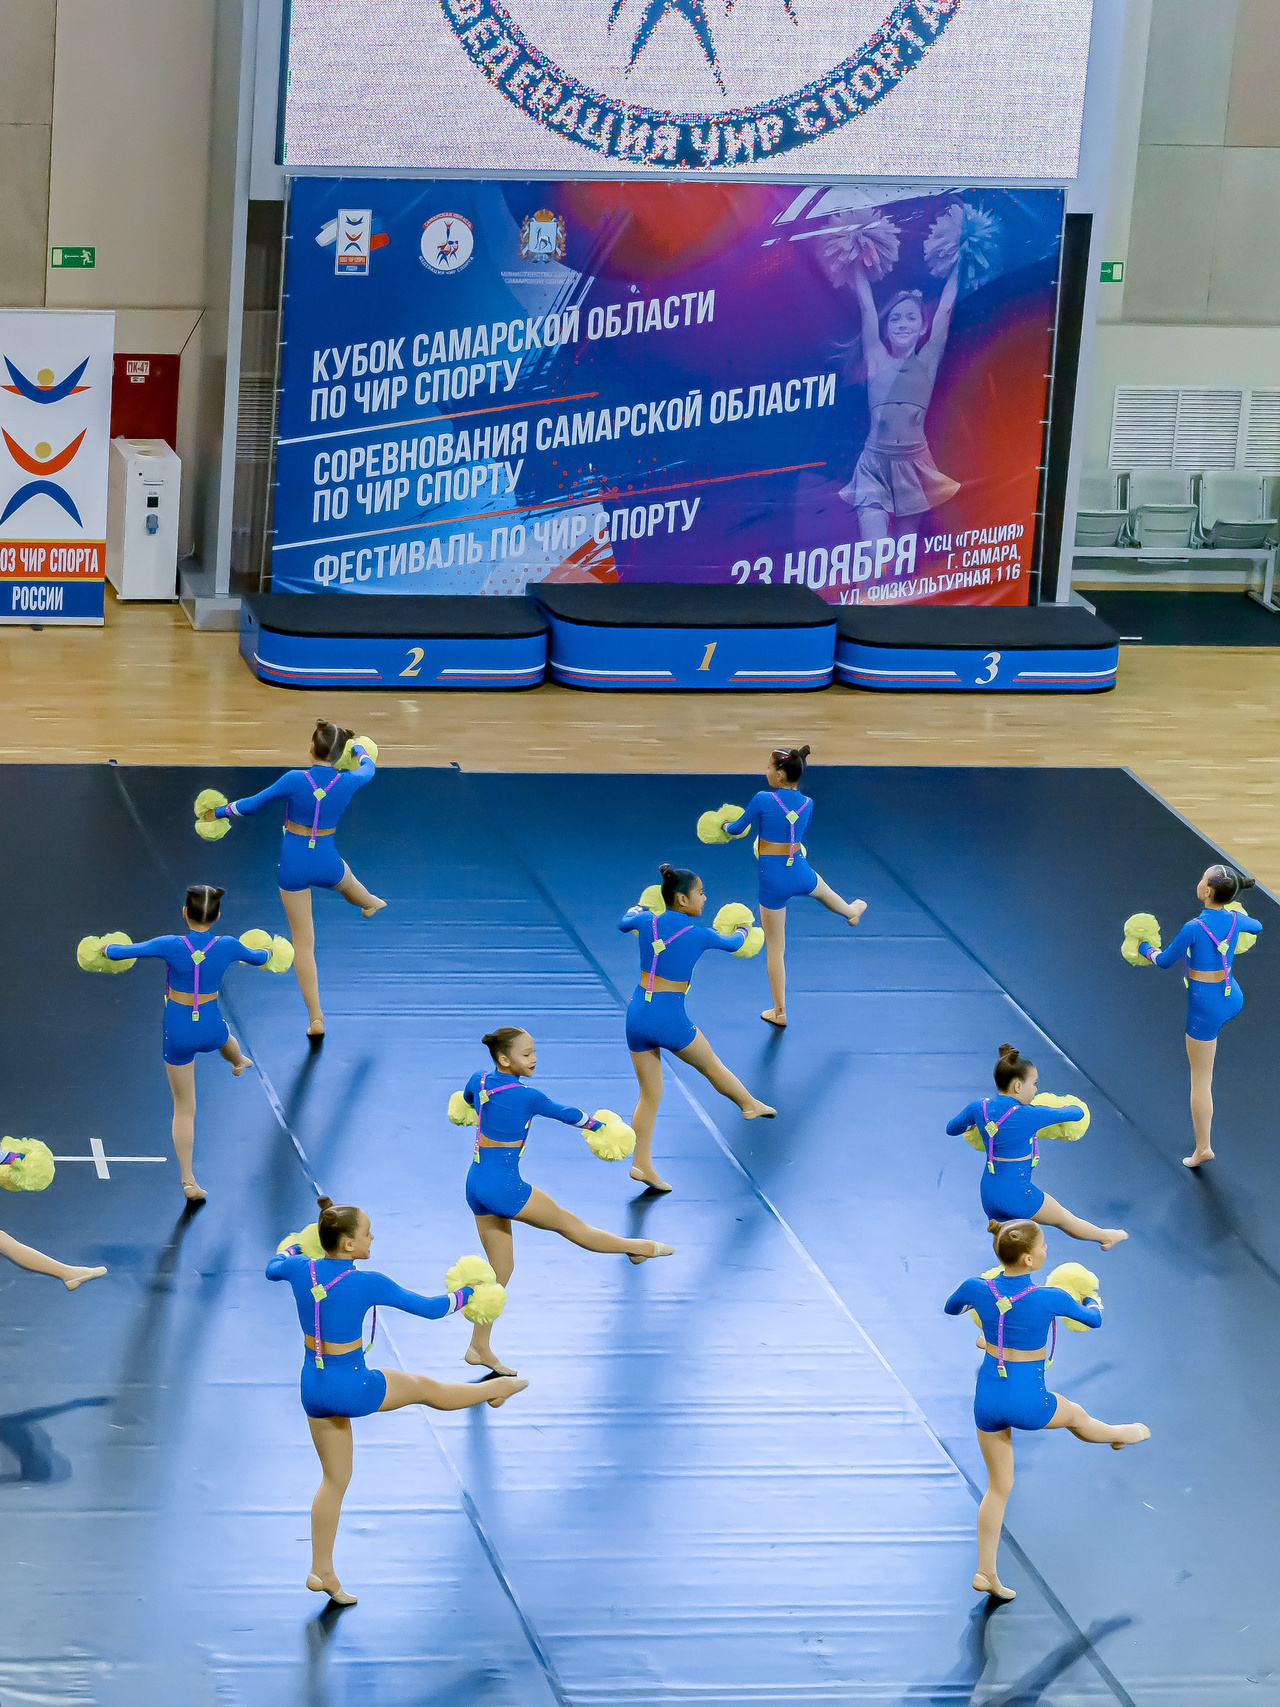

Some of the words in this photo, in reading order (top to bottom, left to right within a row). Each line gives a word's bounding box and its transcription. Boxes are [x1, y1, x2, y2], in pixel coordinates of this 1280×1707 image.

[690, 114, 784, 162] ЧИР
[312, 333, 405, 383] КУБОК
[412, 306, 580, 367] САМАРСКОЙ
[587, 290, 716, 340] ОБЛАСТИ
[310, 385, 346, 421] ПО
[354, 377, 408, 415] ЧИР
[415, 358, 523, 405] СПОРТУ
[313, 421, 528, 486] СОРЕВНОВАНИЯ
[535, 389, 703, 450] САМАРСКОЙ
[709, 373, 837, 422] ОБЛАСТИ
[312, 488, 348, 523] ПО
[356, 477, 409, 516] ЧИР
[416, 459, 523, 507] СПОРТУ
[313, 543, 482, 587] ФЕСТИВАЛЬ
[491, 523, 526, 558] ПО
[533, 513, 587, 552] ЧИР
[593, 497, 700, 546] СПОРТУ
[924, 533, 952, 554] УСЦ
[955, 523, 1024, 549] «ГРАЦИЯ»
[947, 553, 959, 570] Г.
[962, 543, 1022, 569] САМАРА,
[20, 548, 46, 572] ЧИР
[49, 548, 99, 573] СПОРТА
[731, 556, 773, 585] 23
[783, 533, 918, 589] НОЯБРЯ
[12, 586, 64, 611] РОССИИ
[839, 590, 864, 605] УЛ.
[867, 566, 995, 602] ФИЗКУЛЬТУРНАЯ,
[996, 563, 1021, 582] 116
[399, 647, 425, 676] 2
[696, 642, 718, 671] 1
[975, 651, 1002, 685] 3
